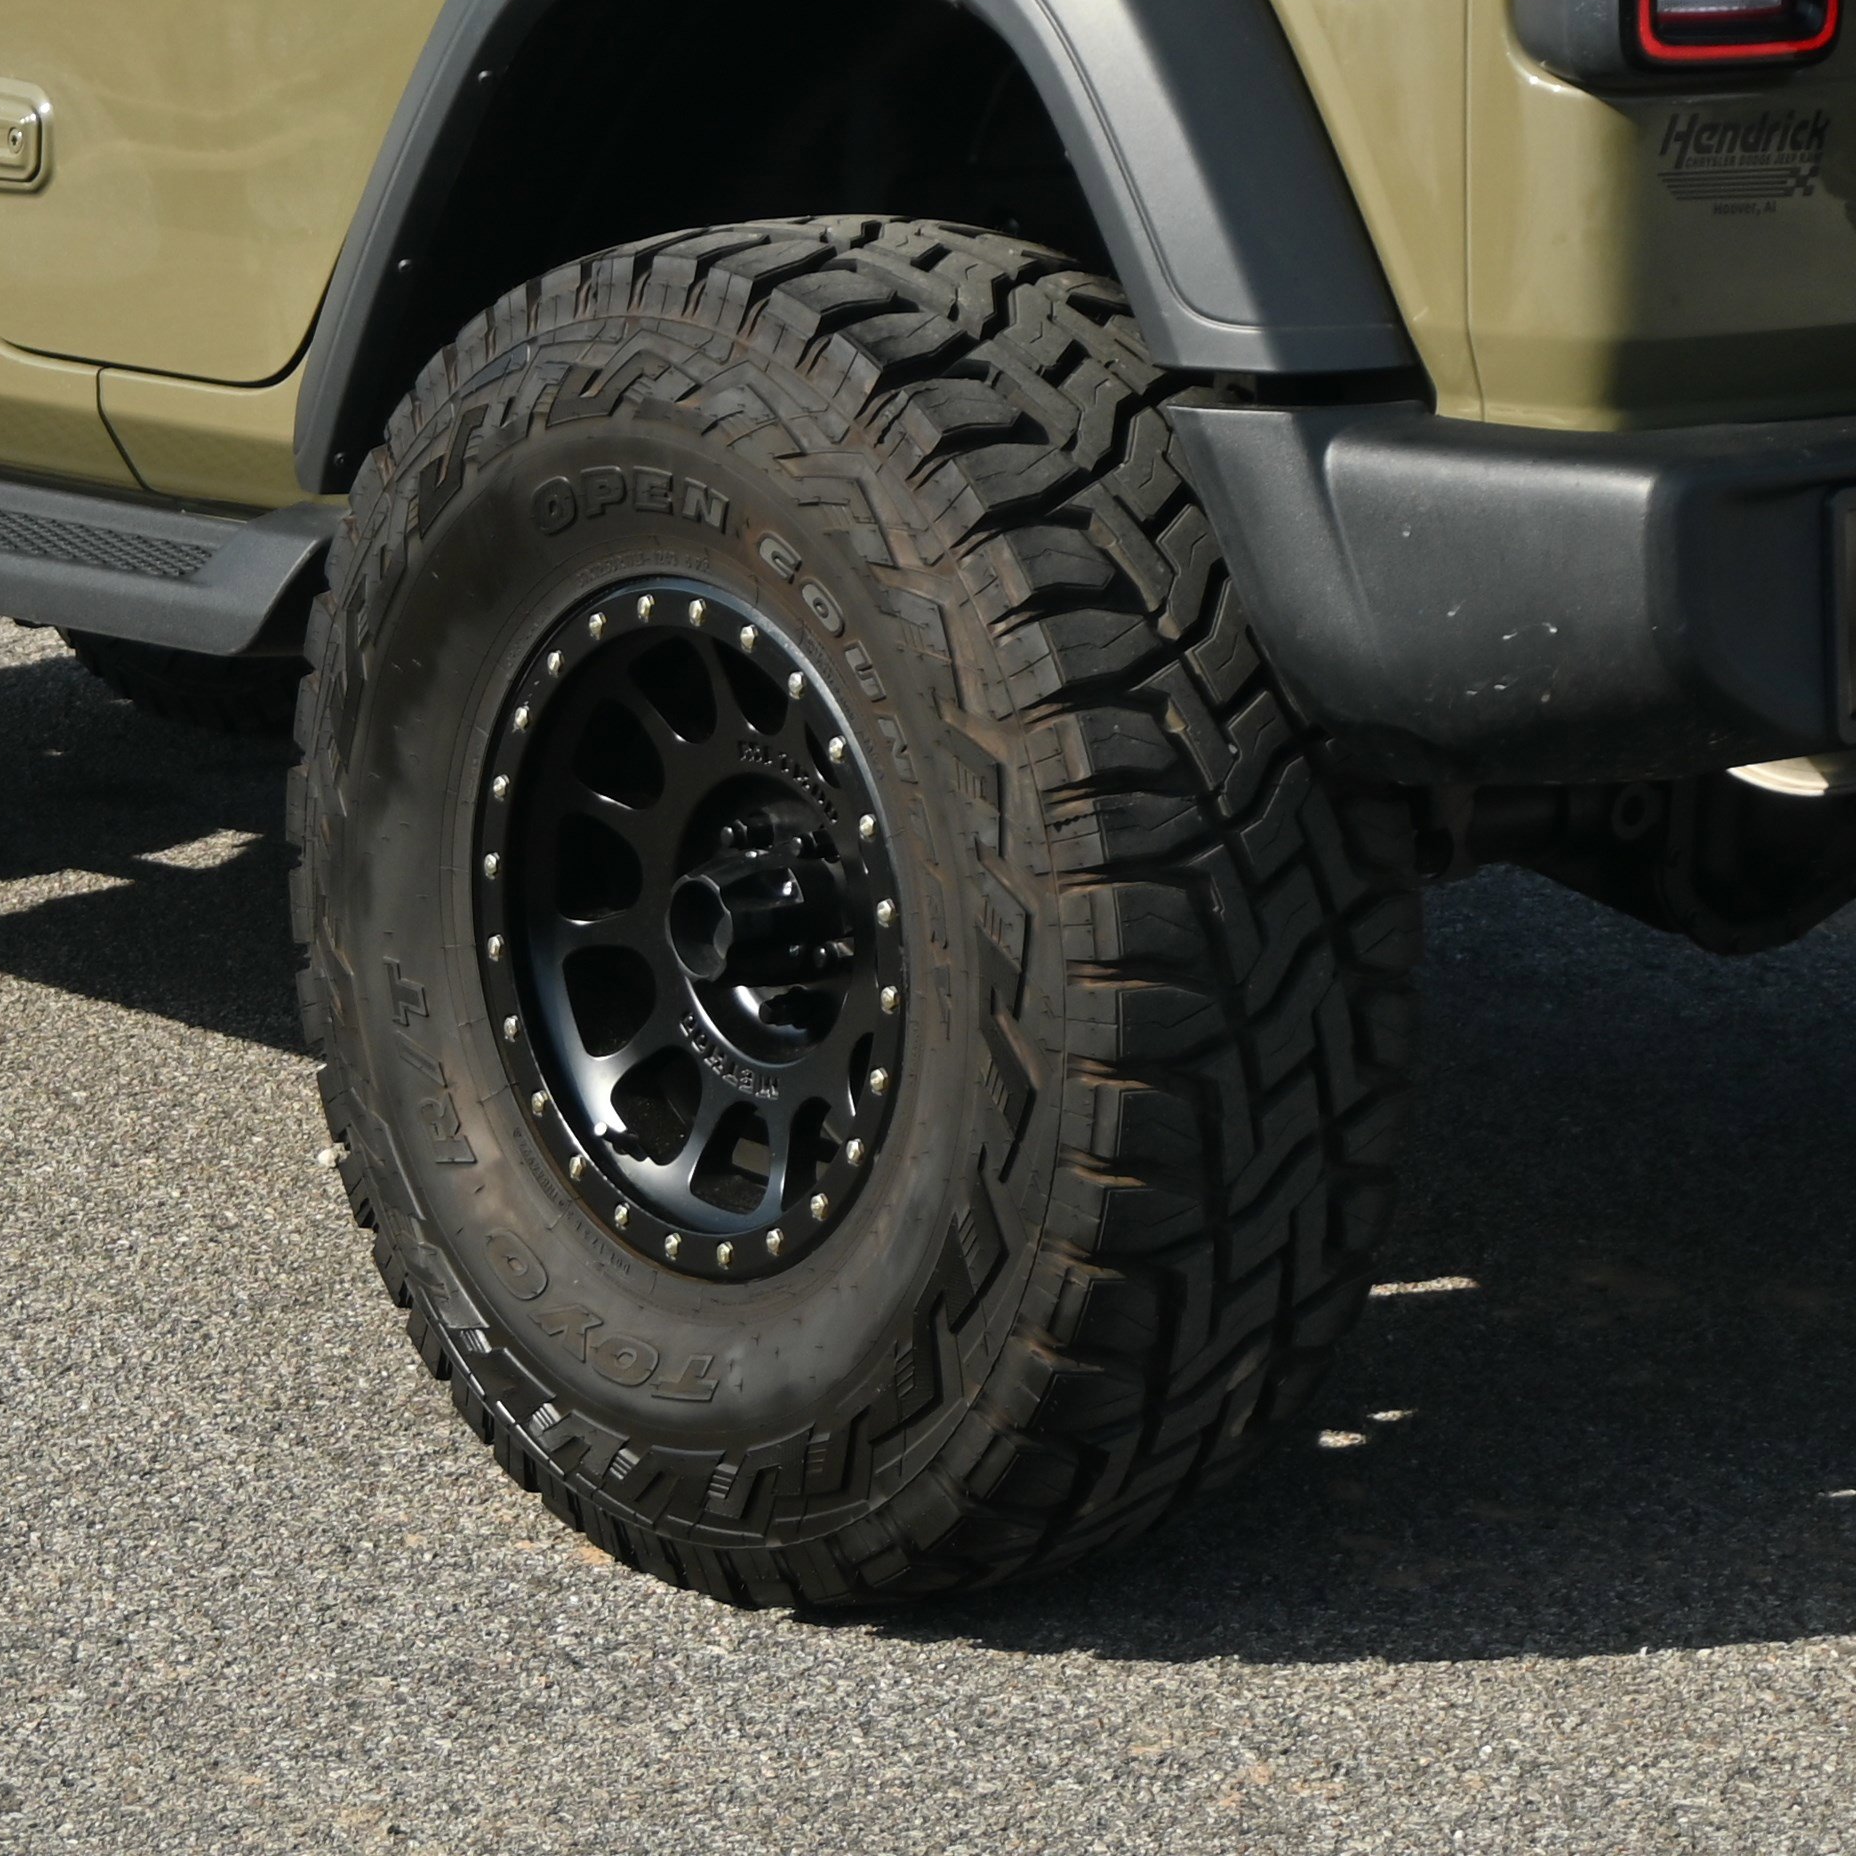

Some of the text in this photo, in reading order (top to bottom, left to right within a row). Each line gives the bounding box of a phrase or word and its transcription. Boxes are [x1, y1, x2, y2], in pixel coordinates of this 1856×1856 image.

[1659, 109, 1831, 169] Hendrick
[531, 464, 732, 536] OPEN
[383, 957, 477, 1164] R/T
[678, 1010, 780, 1101] METHOD
[484, 1229, 721, 1402] TOYO
